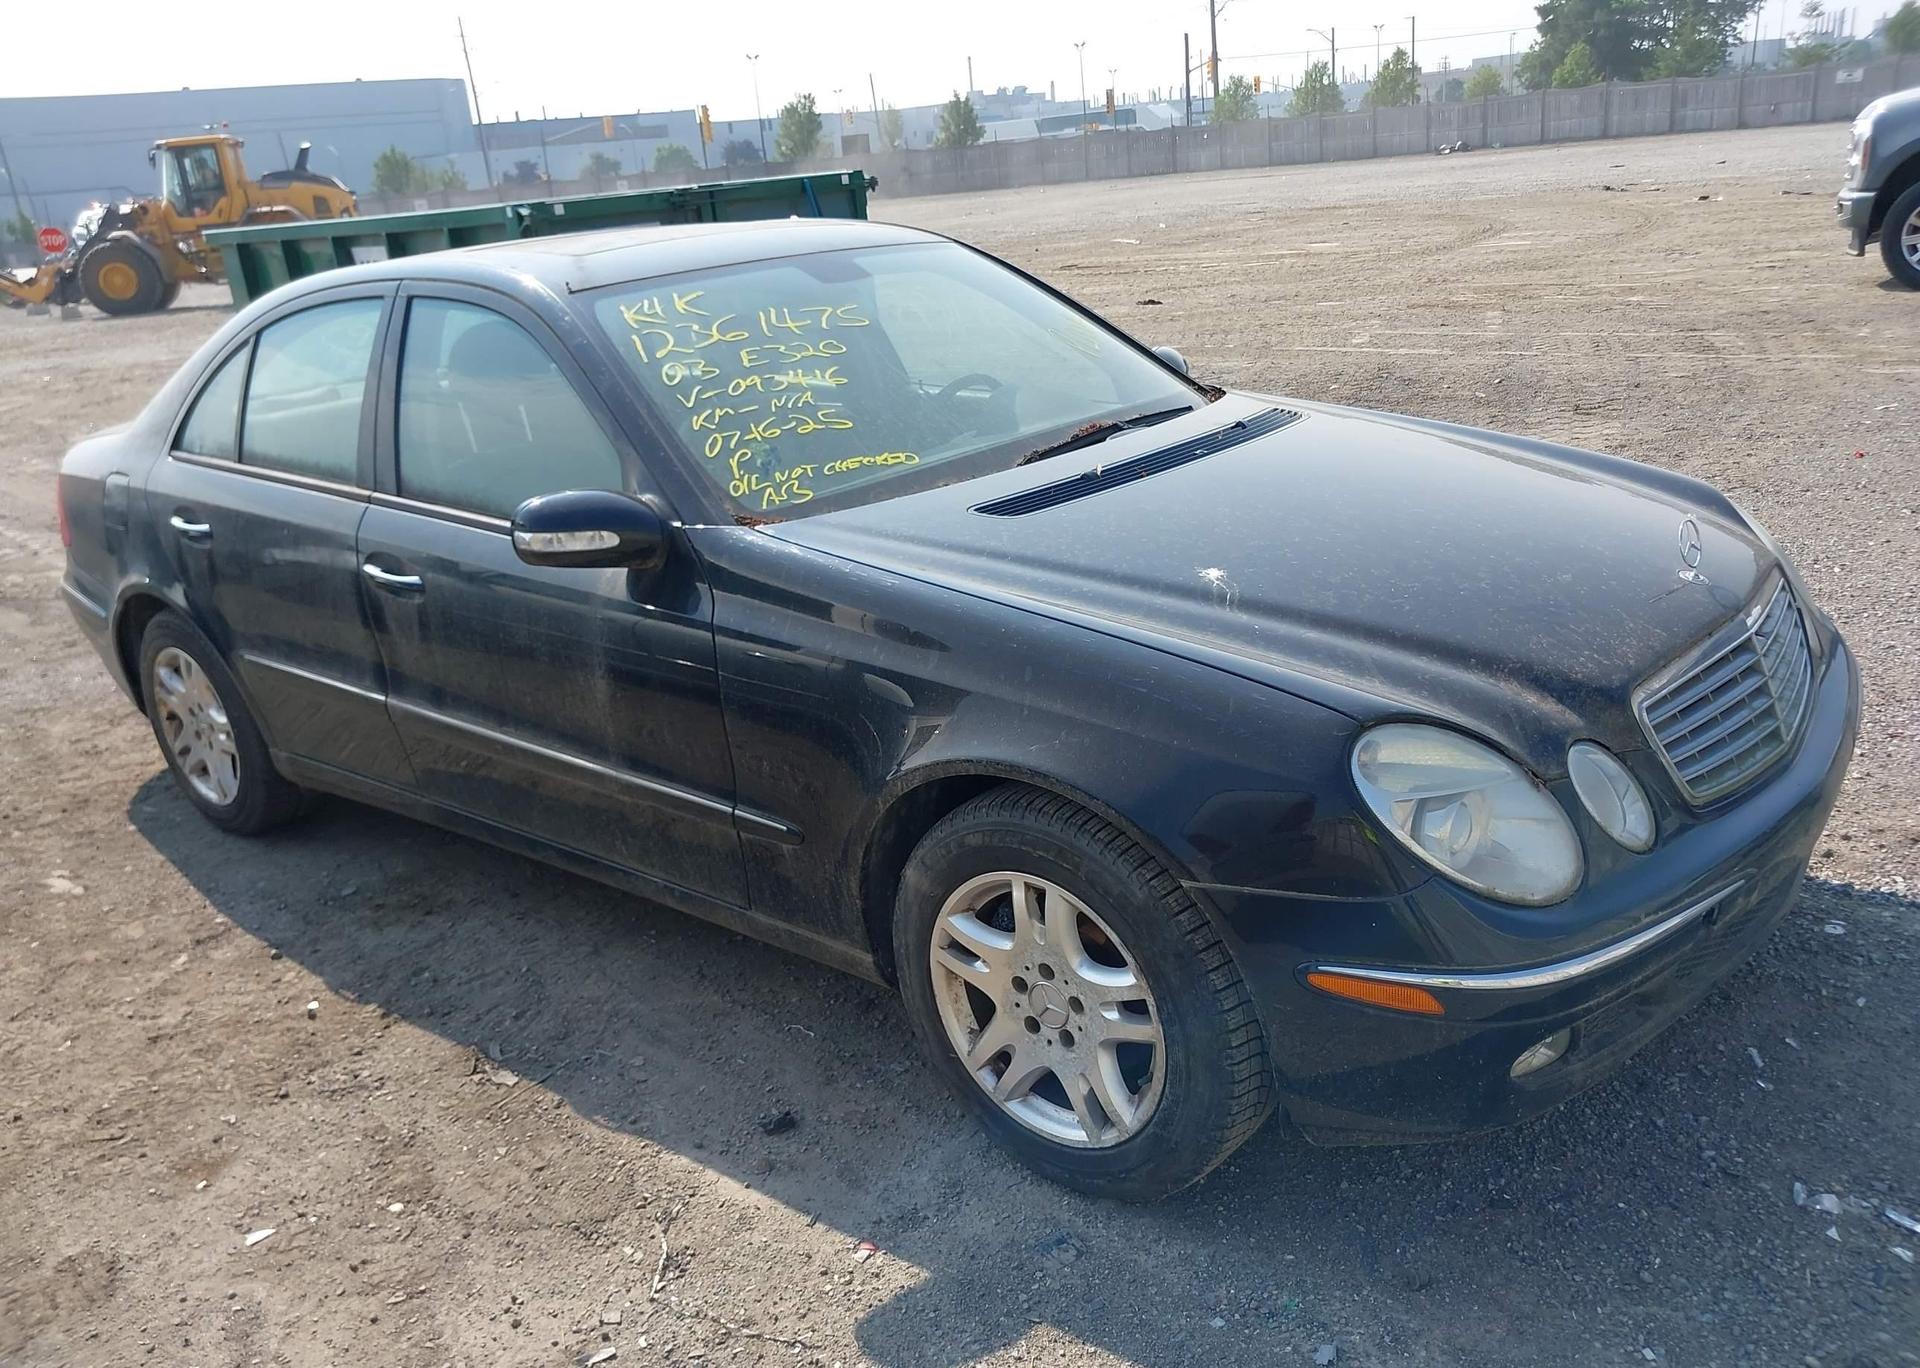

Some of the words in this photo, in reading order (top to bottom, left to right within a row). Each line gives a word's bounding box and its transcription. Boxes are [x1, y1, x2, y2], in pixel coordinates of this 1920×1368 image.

[40, 235, 64, 247] STOP
[740, 339, 847, 368] E320
[774, 463, 819, 484] NOT
[823, 452, 920, 476] CHECKED
